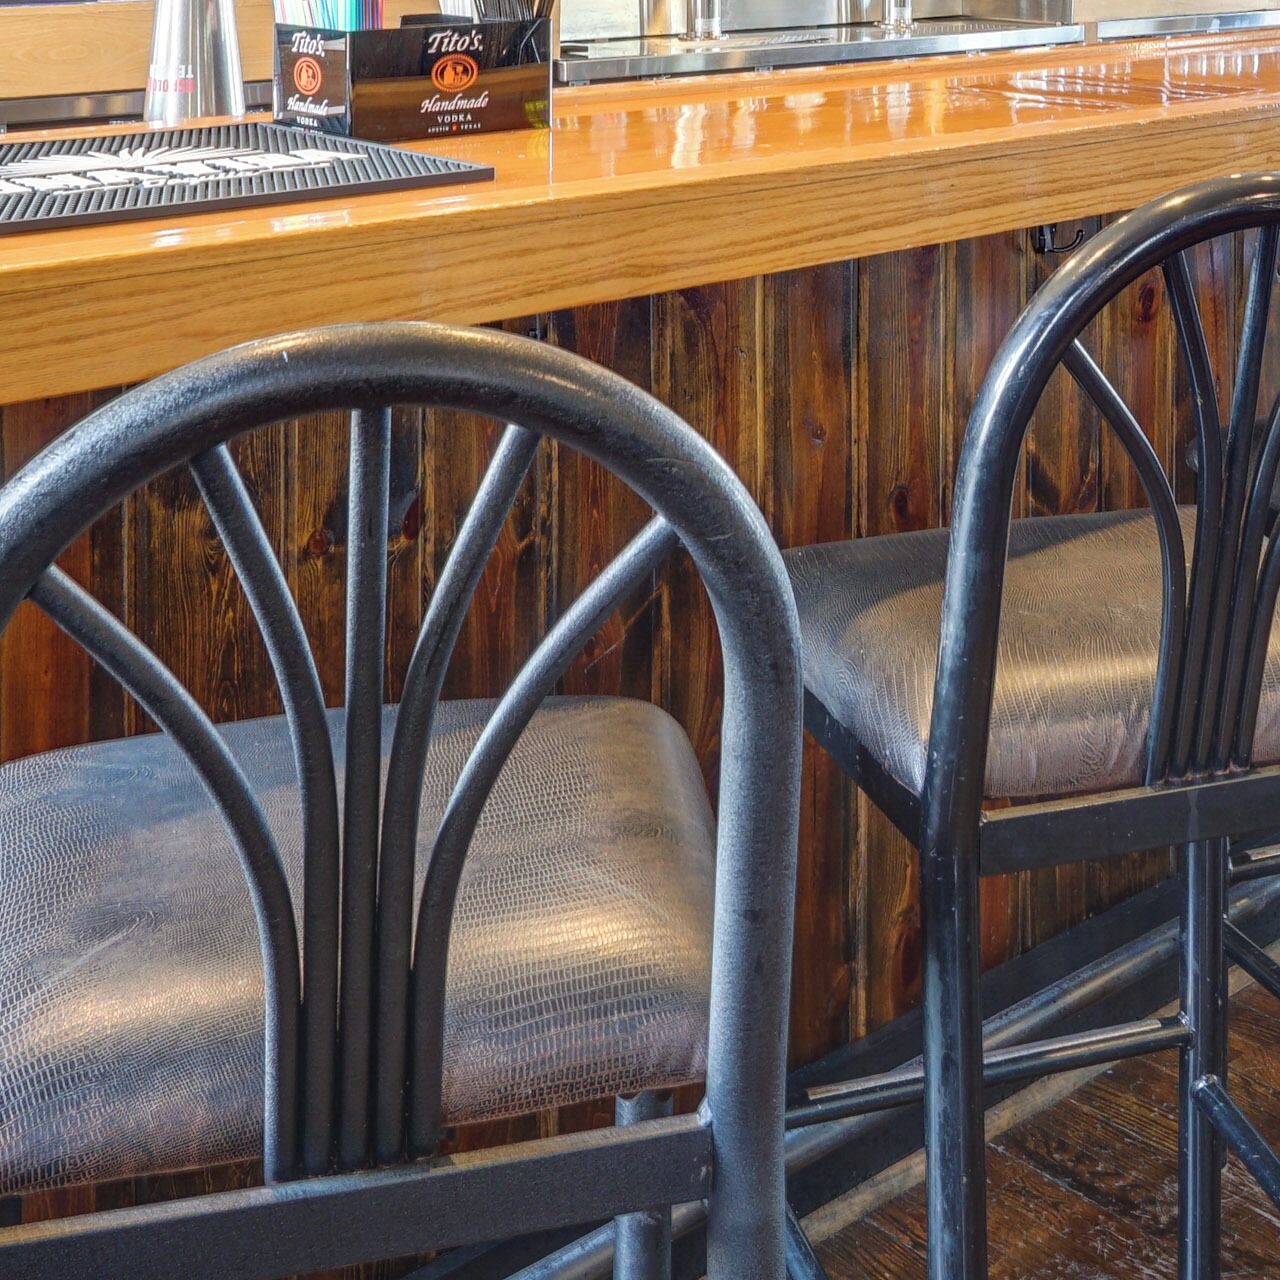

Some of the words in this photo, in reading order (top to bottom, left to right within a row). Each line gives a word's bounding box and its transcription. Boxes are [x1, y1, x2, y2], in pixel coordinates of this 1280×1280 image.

[291, 31, 324, 55] Tito's
[428, 30, 480, 54] Tito's
[287, 94, 328, 116] Handmade
[420, 91, 489, 113] Handmade
[296, 115, 318, 127] VODKA
[437, 112, 472, 123] VODKA
